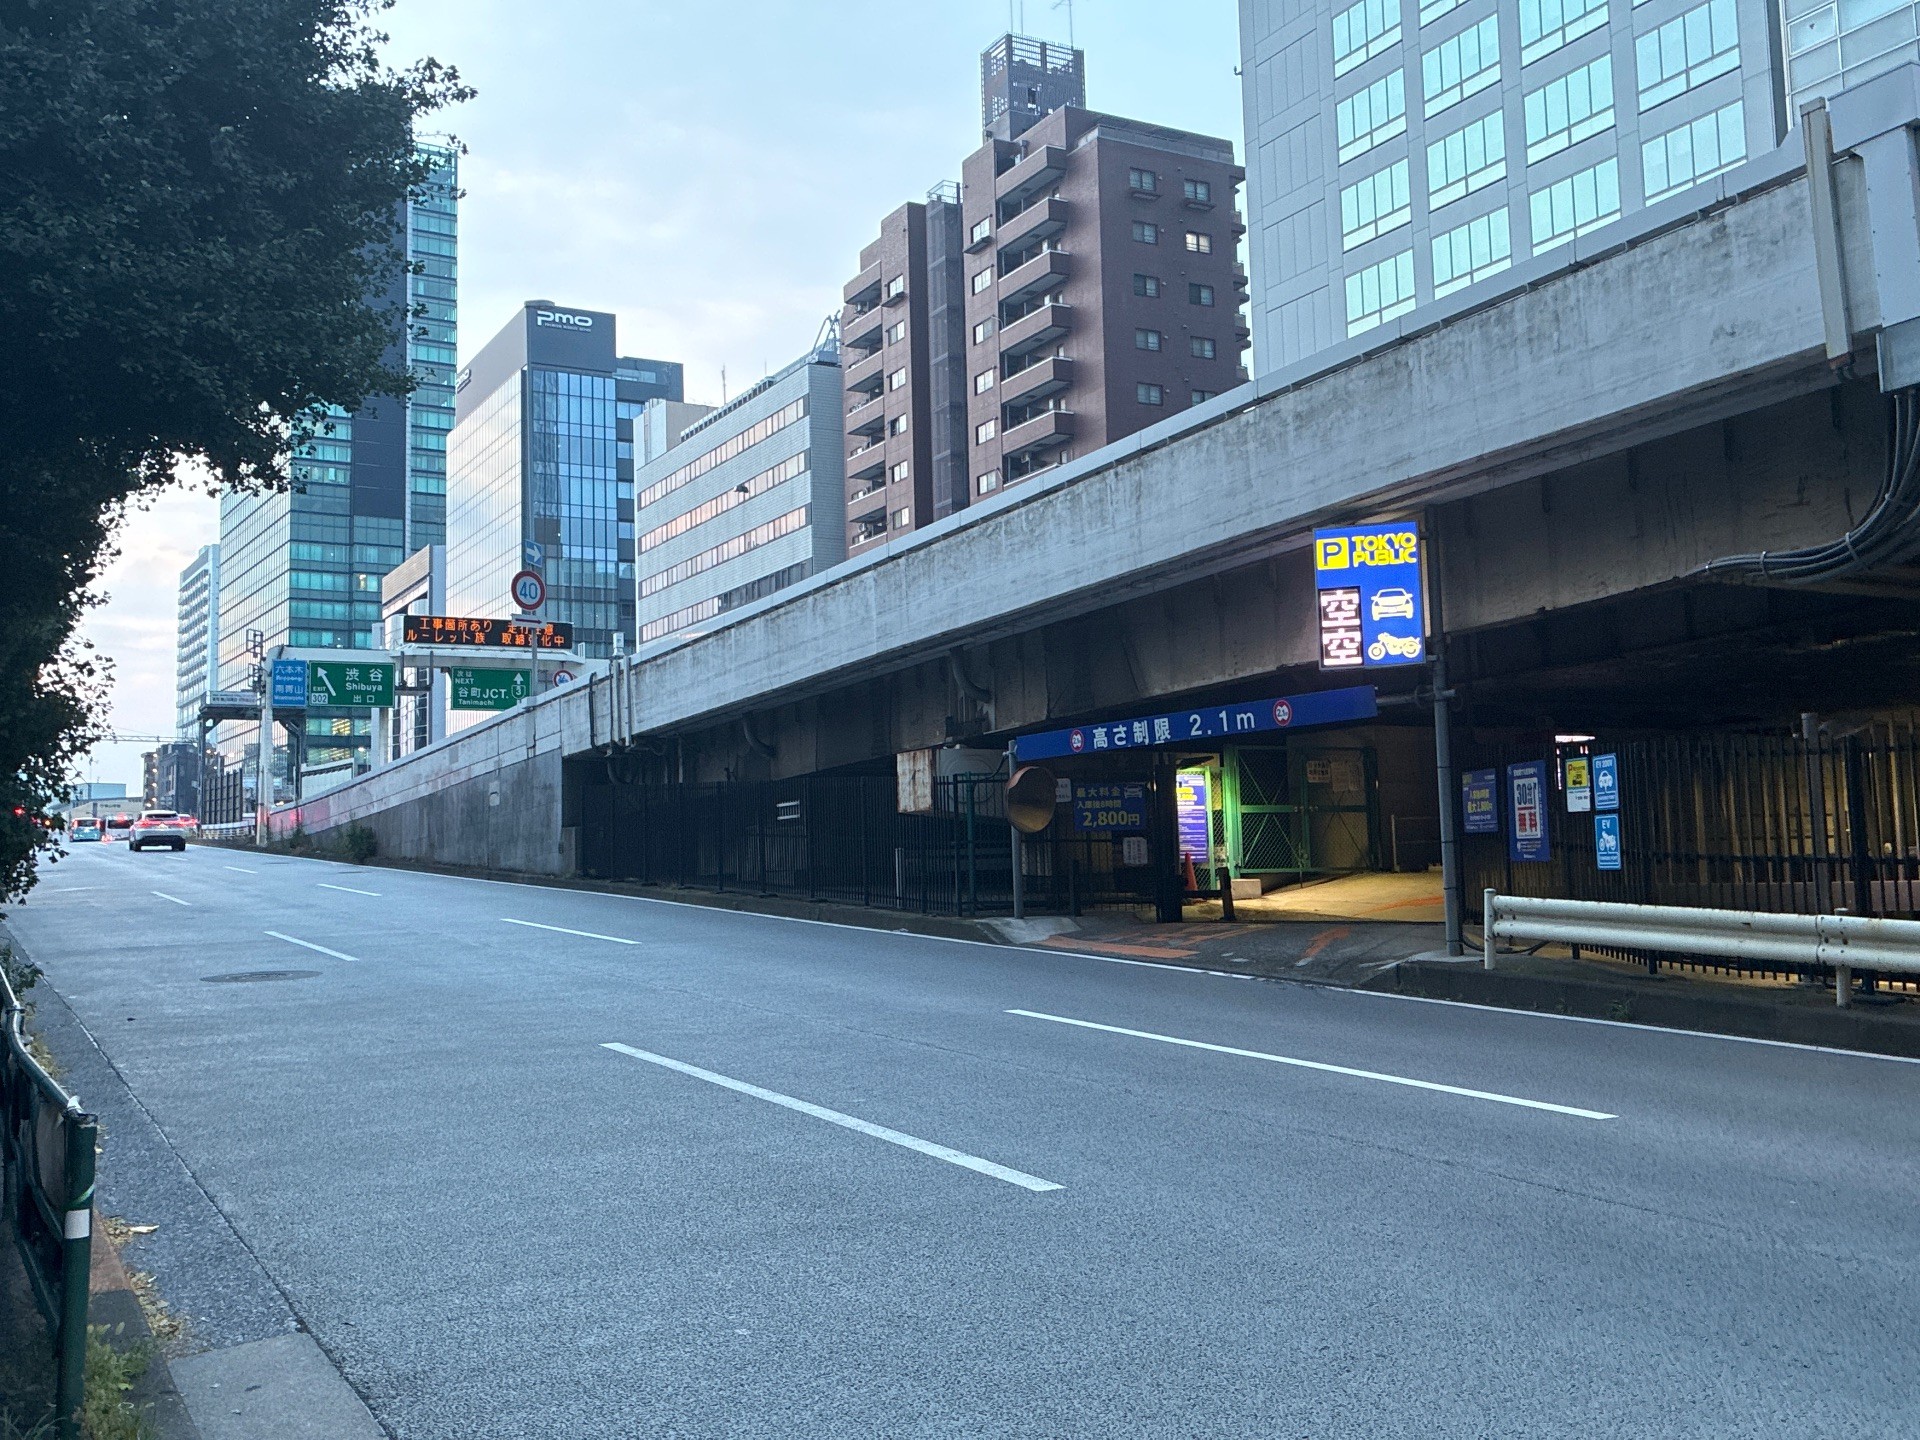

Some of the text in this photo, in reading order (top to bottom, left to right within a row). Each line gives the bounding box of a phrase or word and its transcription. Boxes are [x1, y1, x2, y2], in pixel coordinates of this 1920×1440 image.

[1351, 532, 1417, 551] TOKYO
[1353, 548, 1417, 567] PUBLIC
[519, 581, 538, 600] 40
[1320, 589, 1361, 628] 空
[419, 617, 493, 632] 工事箇所あり
[407, 629, 486, 644] ルーレット族
[1322, 628, 1363, 666] 空
[275, 665, 304, 674] 六本木
[345, 667, 383, 682] 渋谷
[345, 682, 383, 692] Shibuya
[312, 695, 327, 703] 302
[353, 695, 375, 703] 出口
[1092, 710, 1256, 750] 高さ制限 2.1m
[1076, 786, 1121, 798] 最大料金
[1082, 810, 1140, 828] 2,800円
[1601, 819, 1611, 830] EV
